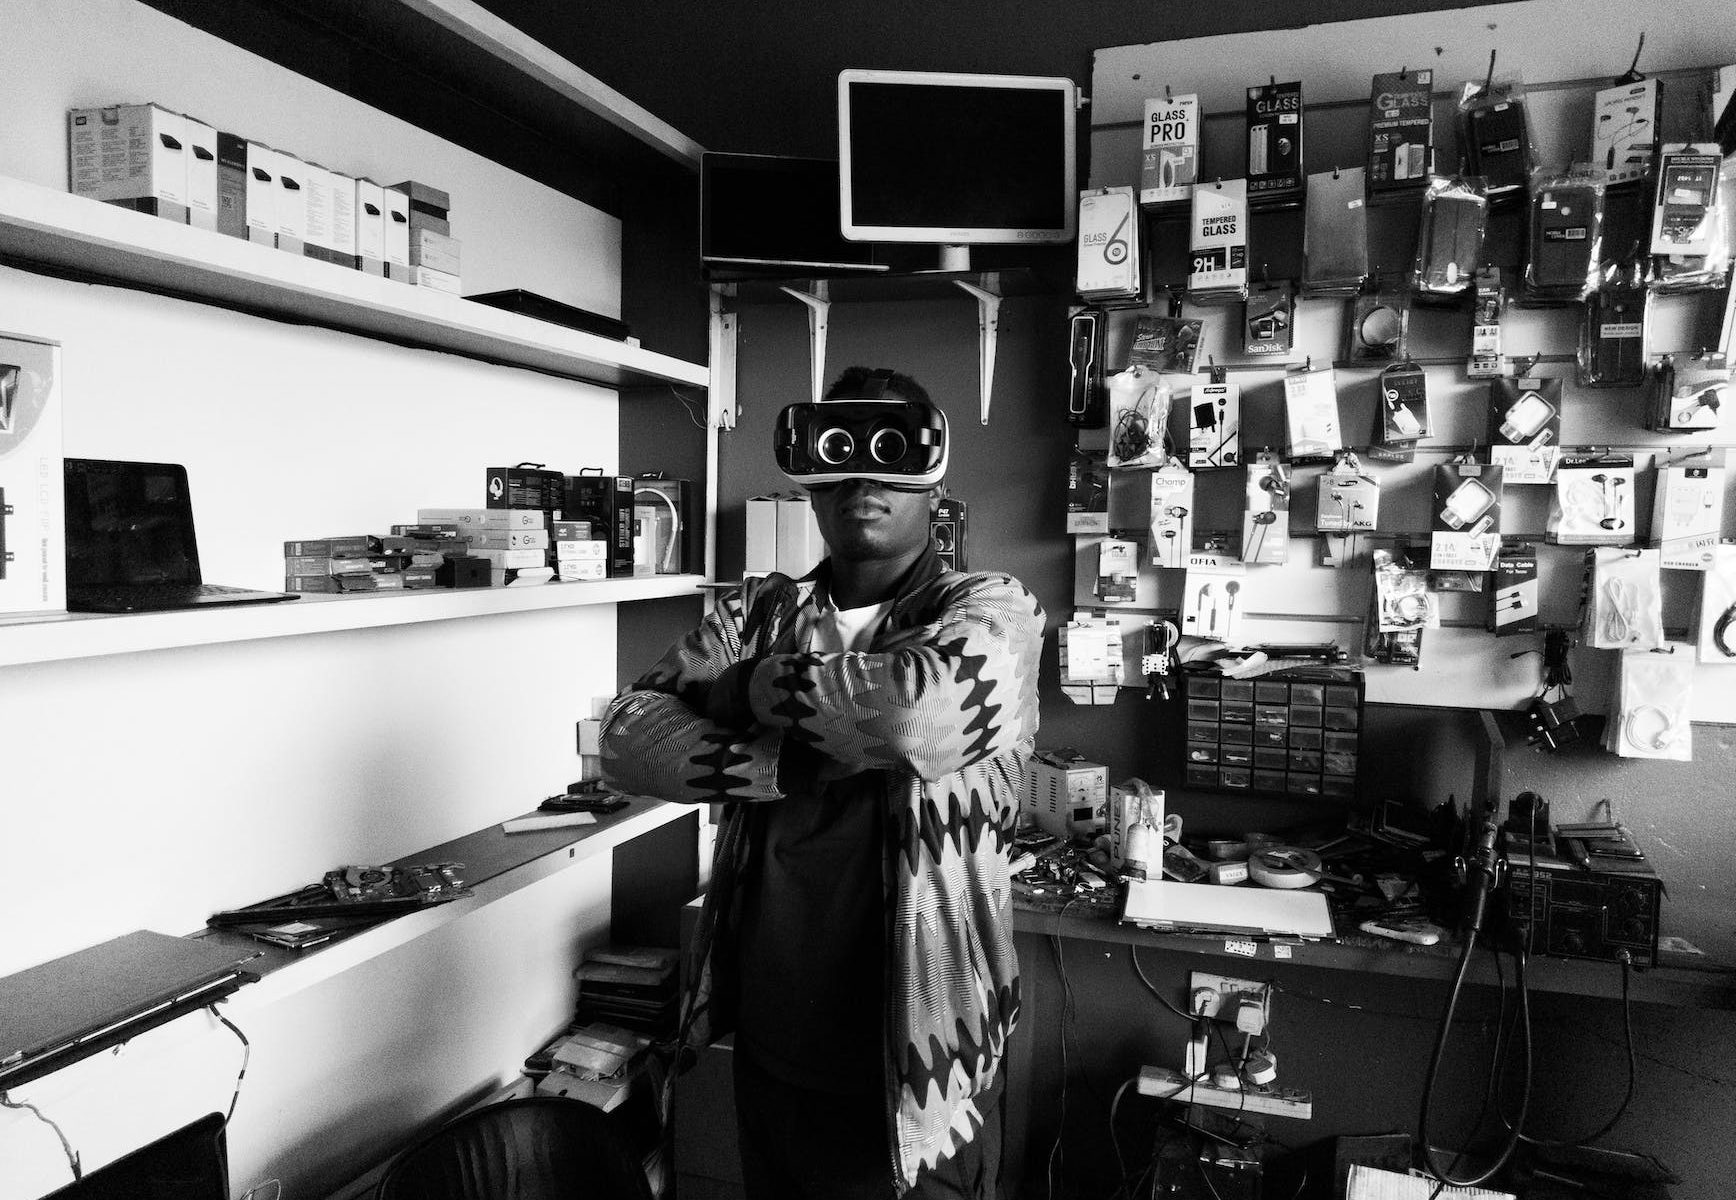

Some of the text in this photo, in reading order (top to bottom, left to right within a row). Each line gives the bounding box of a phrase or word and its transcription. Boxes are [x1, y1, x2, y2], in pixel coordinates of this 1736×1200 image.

[1256, 97, 1299, 114] GLASS
[1376, 92, 1428, 110] GLASS
[1151, 109, 1185, 123] GLASS
[1399, 118, 1430, 127] TEMPERED
[1151, 122, 1185, 143] PRO
[1374, 133, 1389, 142] XS
[1202, 215, 1236, 225] TEMPERED
[1203, 223, 1236, 237] GLASS
[1083, 232, 1107, 243] GLASS
[1193, 257, 1215, 274] 9H
[1248, 343, 1283, 353] SanDisk
[1155, 477, 1186, 488] Champ
